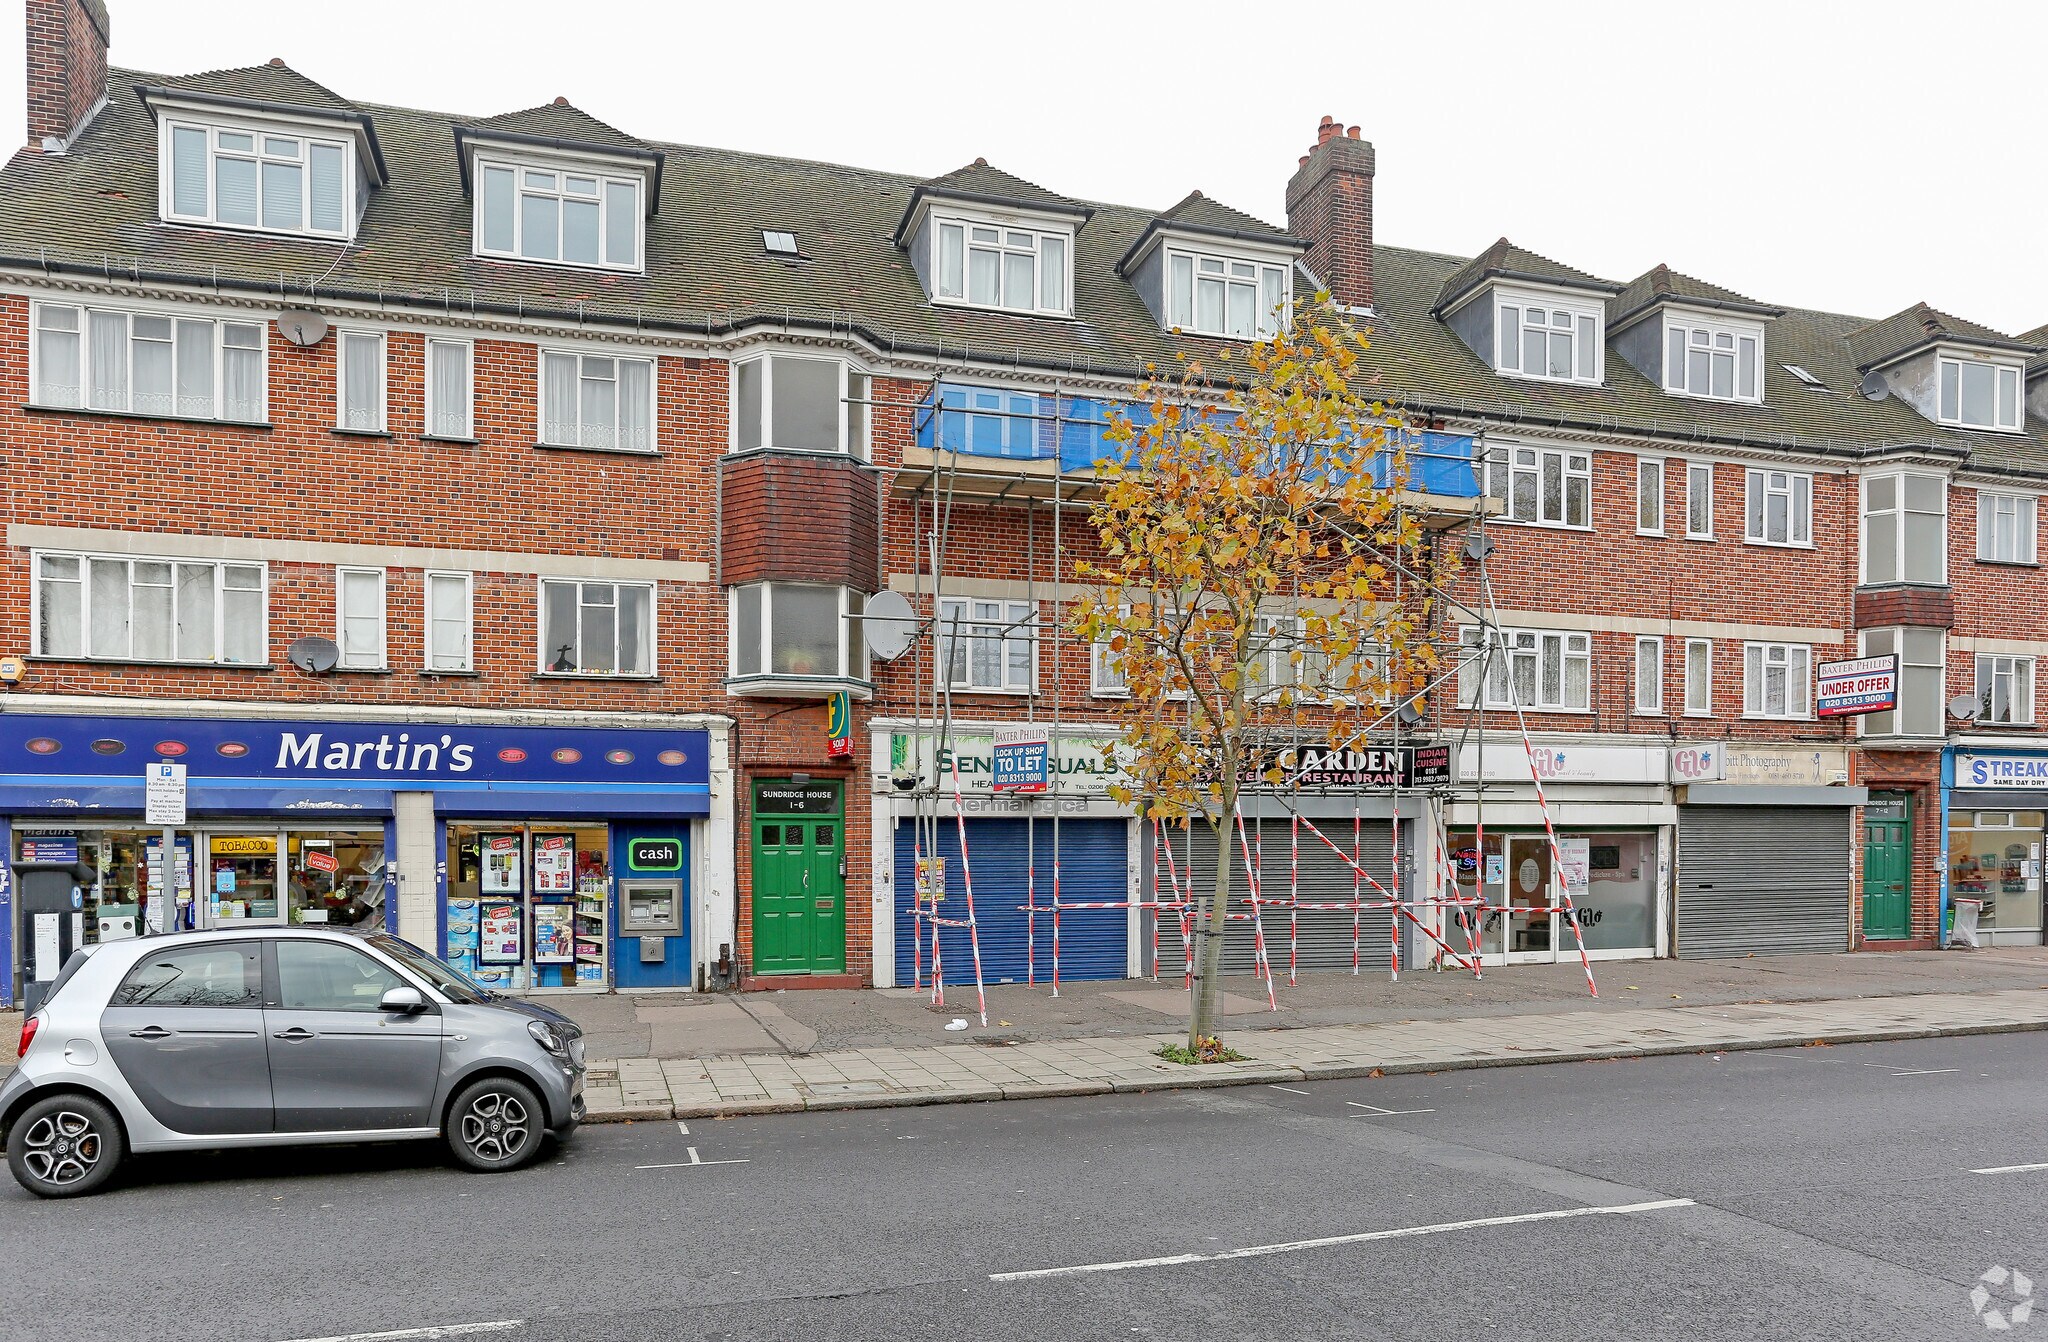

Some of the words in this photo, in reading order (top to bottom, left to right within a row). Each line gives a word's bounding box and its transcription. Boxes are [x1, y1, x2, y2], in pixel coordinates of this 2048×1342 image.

[1822, 664, 1853, 675] BAXTER
[1856, 658, 1892, 671] PHILIPS
[1822, 681, 1855, 696] UNDER
[1858, 677, 1890, 693] OFFER
[1825, 699, 1840, 707] 020
[1842, 697, 1863, 705] 8313
[1865, 694, 1887, 702] 9000
[995, 731, 1018, 742] BAXTER
[1020, 728, 1046, 740] PHILIPS
[832, 738, 846, 748] SOLD
[275, 732, 475, 772] Martin's
[996, 748, 1013, 757] LOCK
[1014, 747, 1024, 756] UP
[1025, 746, 1045, 755] SHOP
[1417, 748, 1447, 758] INDIAN
[998, 758, 1014, 772] TO
[1017, 756, 1042, 771] LET
[1415, 758, 1448, 768] CUISINE
[1674, 750, 1711, 778] Glo
[1740, 753, 1791, 771] Photography
[998, 774, 1008, 782] 020
[1009, 773, 1024, 782] 8313
[1025, 773, 1042, 782] 9000
[1302, 773, 1405, 784] RESTAURANT
[762, 790, 804, 799] SUNDRIDGE
[806, 791, 832, 799] HOUSE
[219, 841, 268, 852] TOBACCO
[638, 846, 673, 860] cash
[312, 860, 331, 869] value
